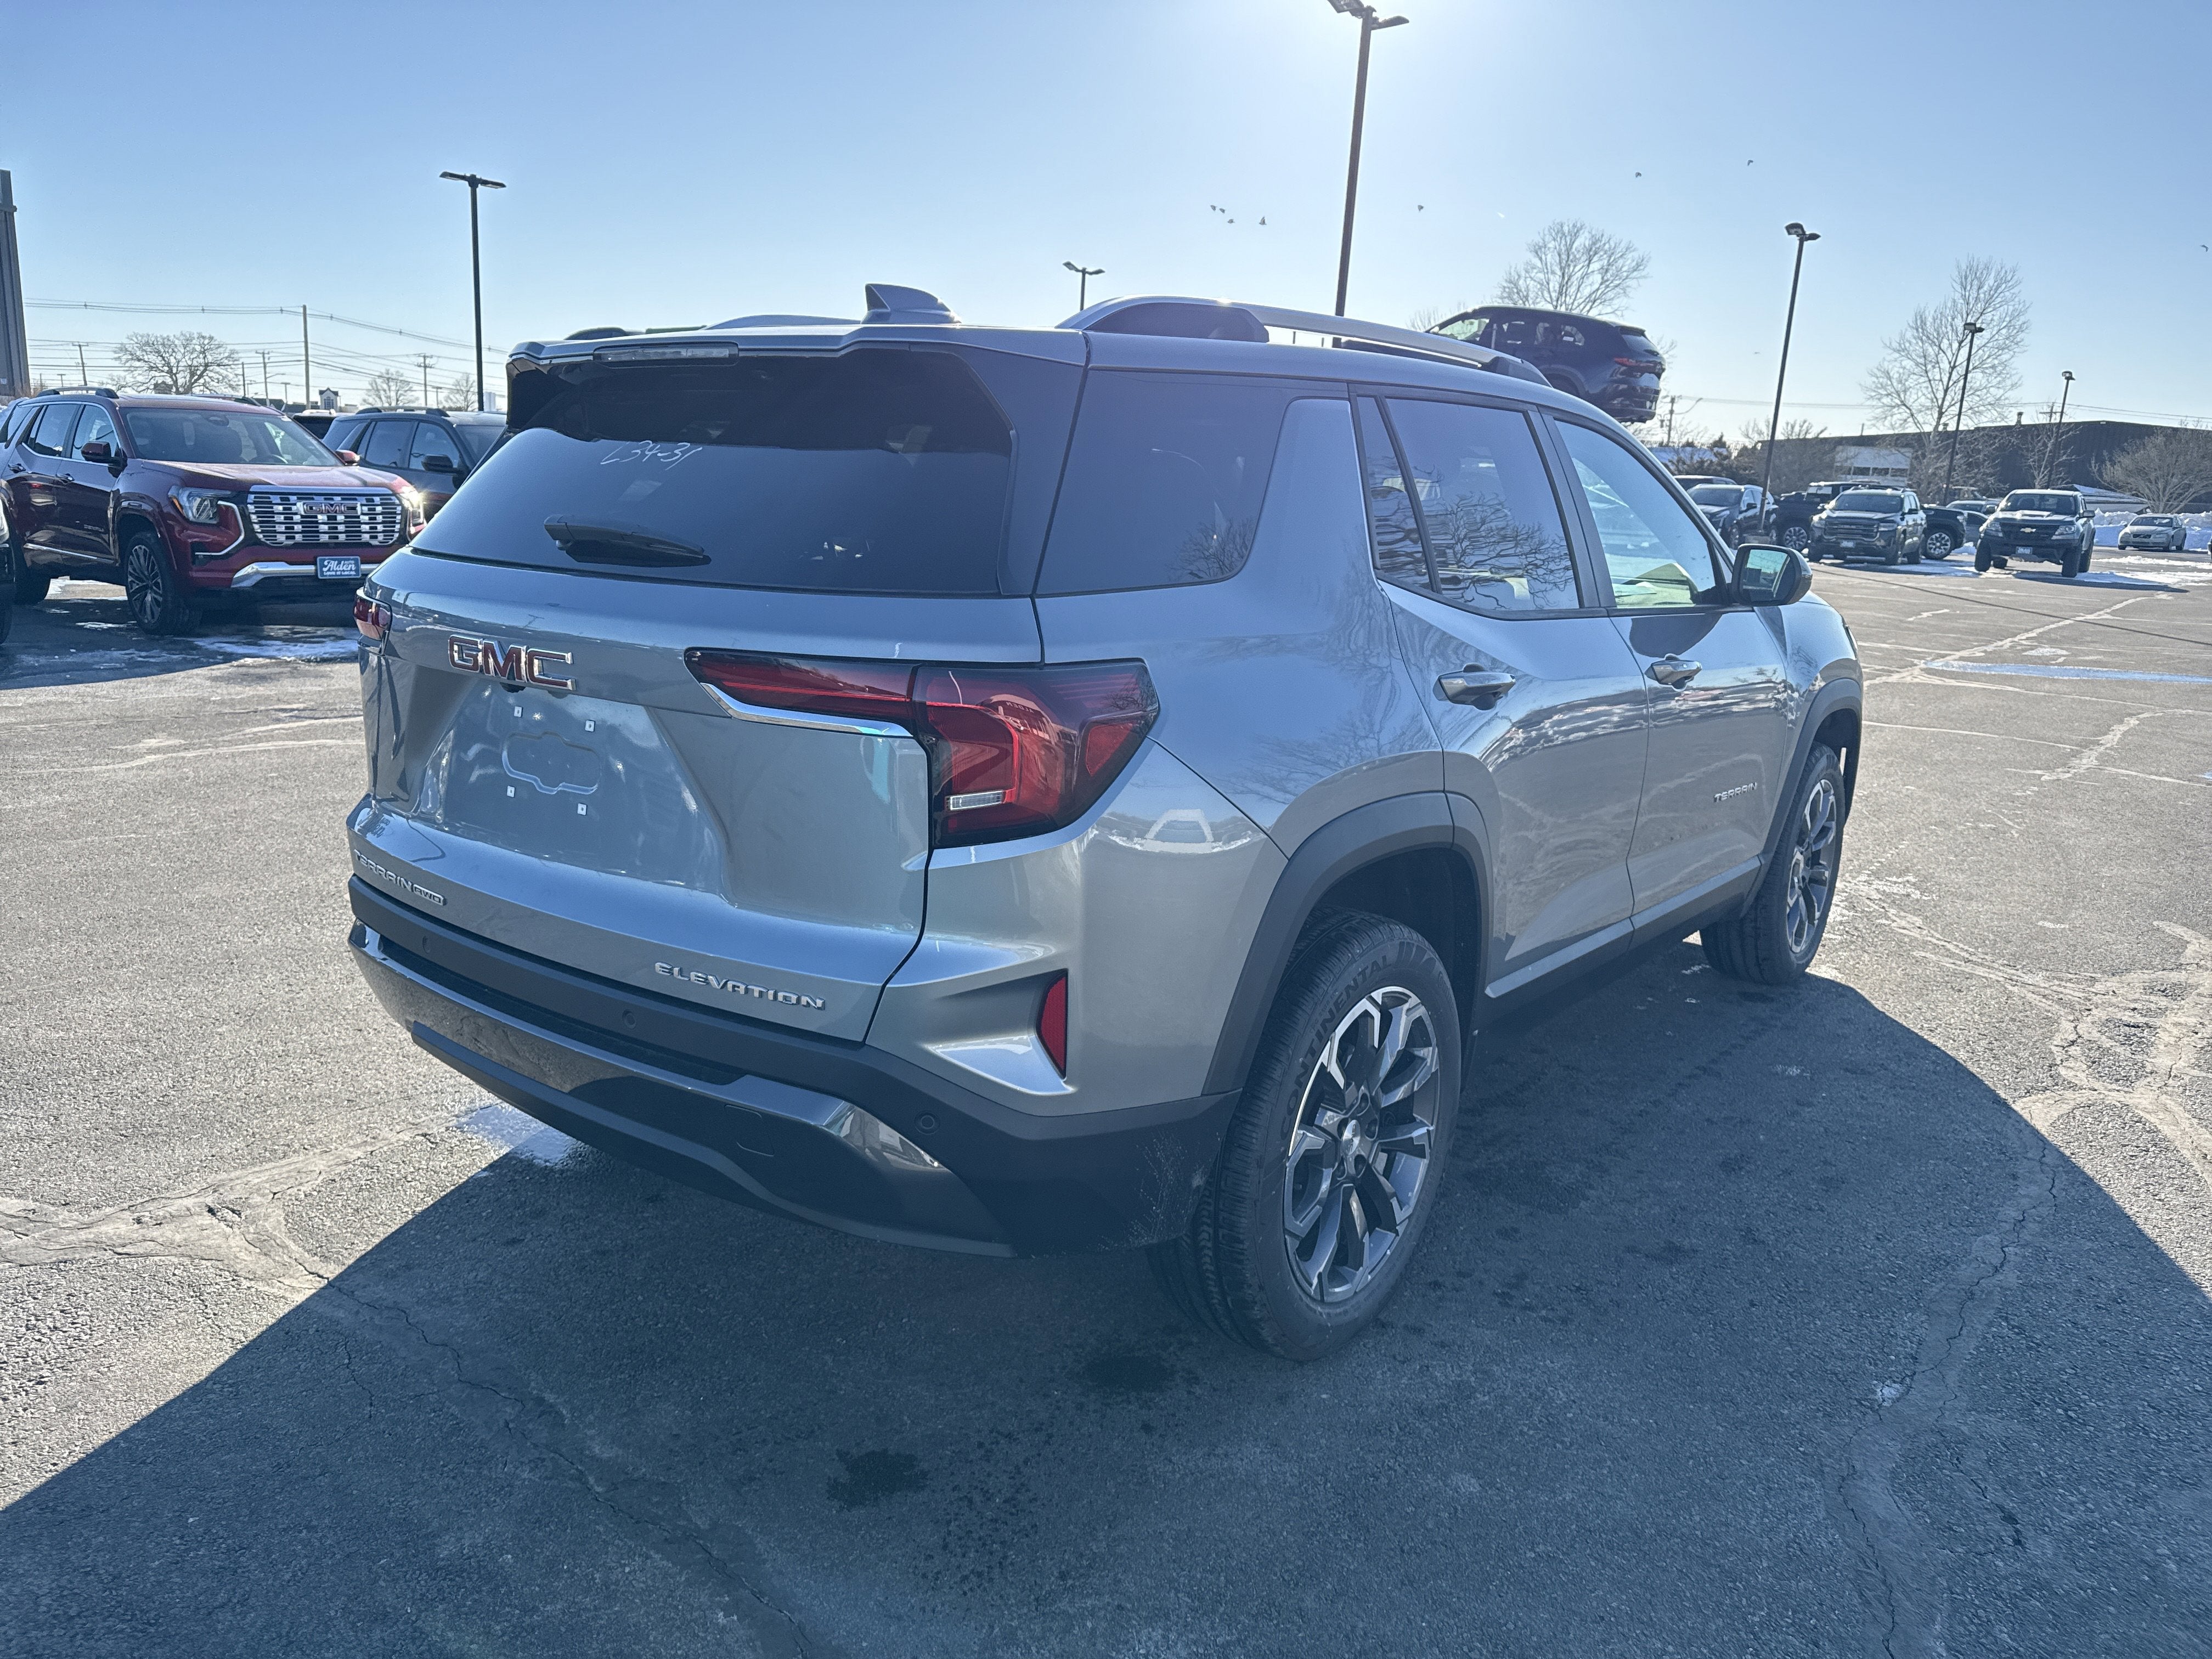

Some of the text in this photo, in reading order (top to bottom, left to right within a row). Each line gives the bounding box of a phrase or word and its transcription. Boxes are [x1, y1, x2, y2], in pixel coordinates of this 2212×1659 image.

[303, 502, 360, 515] GMC
[323, 560, 356, 571] Alden
[448, 635, 577, 691] GMC
[1713, 782, 1757, 803] TERRAIN
[354, 849, 442, 904] TERRAIN AWD
[655, 962, 825, 1011] ELEVATION
[1280, 955, 1392, 1141] CONTINENTAL
